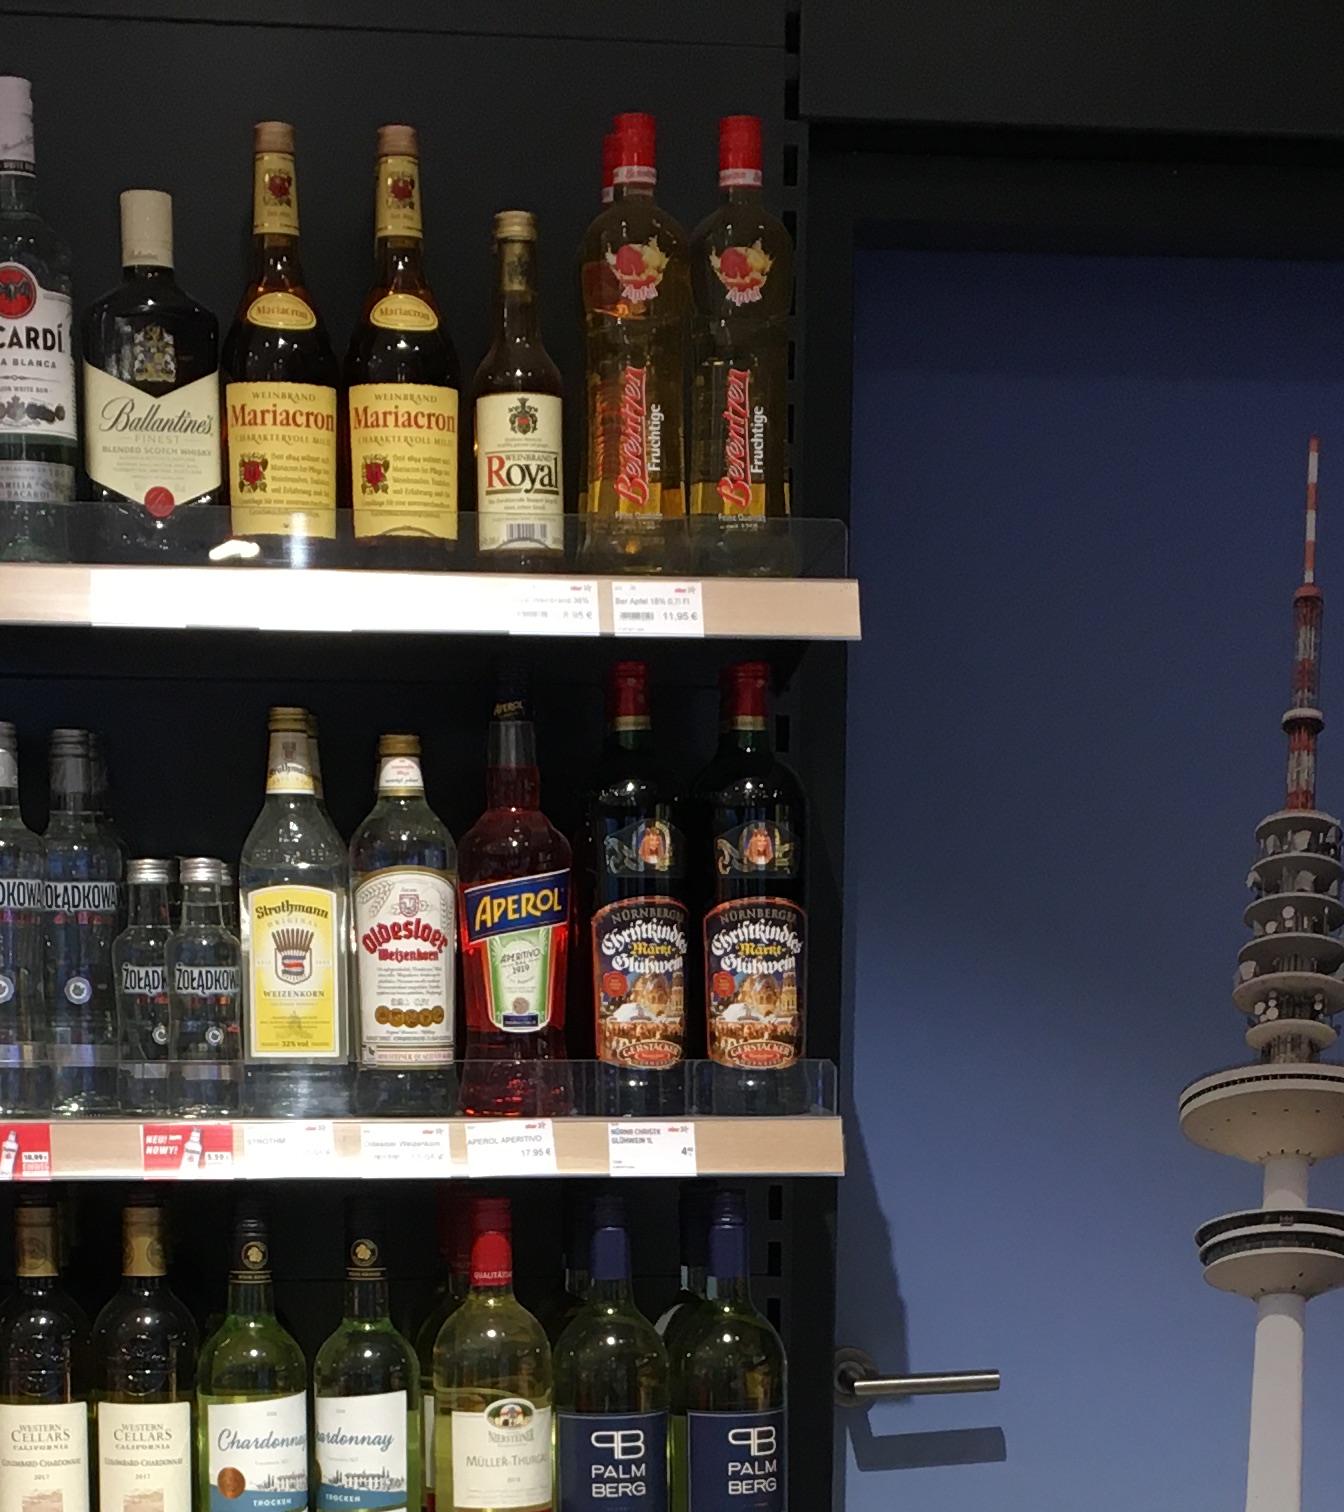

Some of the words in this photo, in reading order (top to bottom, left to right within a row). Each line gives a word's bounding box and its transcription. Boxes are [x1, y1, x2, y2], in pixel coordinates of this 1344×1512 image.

[12, 357, 57, 369] BLANCA
[252, 391, 316, 402] WEINBRAND
[231, 403, 334, 433] Mariacron
[354, 404, 456, 434] Mariacron
[134, 434, 180, 444] FINEST
[751, 406, 768, 474] Fruchtige
[102, 446, 140, 455] BLENDED
[144, 447, 177, 456] SCOTCH
[486, 456, 560, 495] Royal
[255, 901, 328, 920] Strothmann
[474, 889, 561, 931] APEROL
[267, 919, 317, 928] ORIGINAL
[500, 949, 540, 965] APERITIVO
[512, 965, 530, 974] 1919
[263, 990, 325, 999] WEIZENKORN
[468, 1137, 497, 1146] APEROL
[500, 1135, 542, 1144] APERITIVO
[19, 1423, 62, 1433] WESTERN
[10, 1428, 71, 1444] CELLARS
[592, 1463, 646, 1478] PALM
[592, 1482, 646, 1498] BERG
[253, 1498, 292, 1507] TROCKEN
